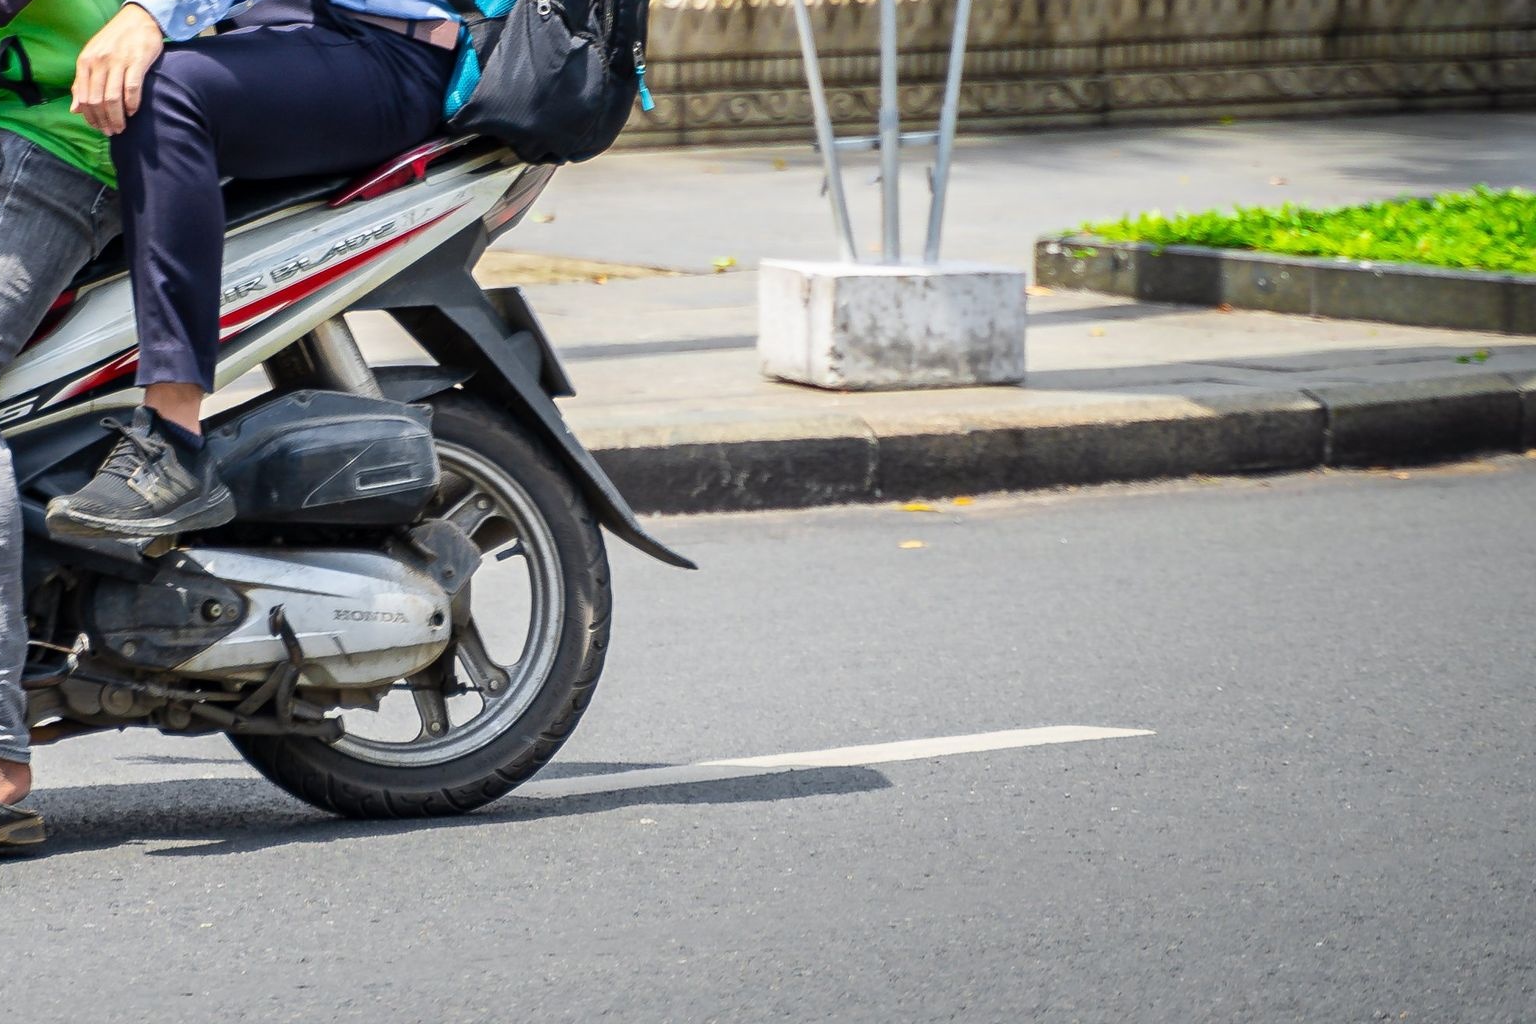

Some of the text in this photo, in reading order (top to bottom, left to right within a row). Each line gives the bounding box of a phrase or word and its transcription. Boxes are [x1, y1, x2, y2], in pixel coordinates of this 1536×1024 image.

[221, 219, 398, 304] IR BLADE
[332, 608, 410, 624] HONDA
